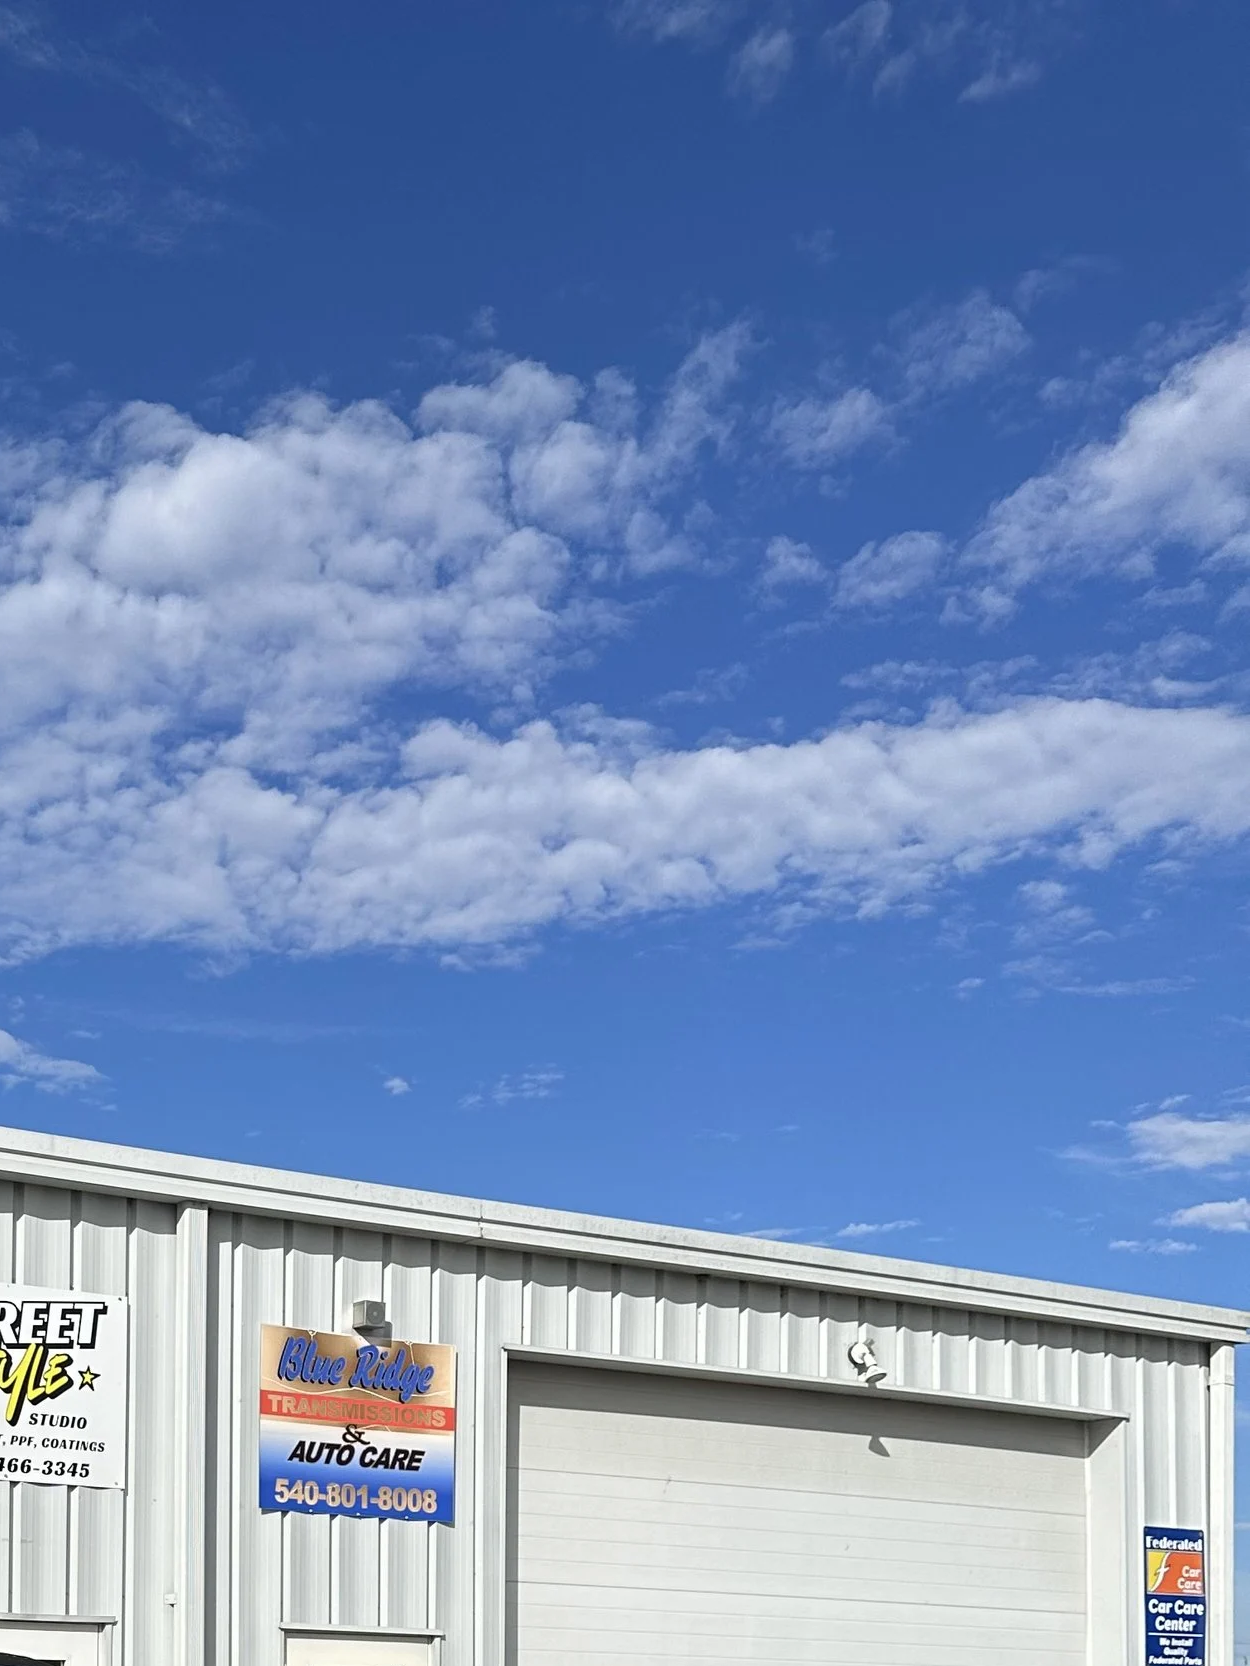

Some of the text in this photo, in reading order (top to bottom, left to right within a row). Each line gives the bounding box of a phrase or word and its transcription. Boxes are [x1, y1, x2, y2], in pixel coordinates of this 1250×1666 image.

[278, 1336, 435, 1404] Blue Ridge
[267, 1393, 447, 1428] TRANSMISSIONS
[28, 1412, 88, 1430] STUDIO
[341, 1423, 371, 1445] &
[10, 1435, 38, 1449] PPF,
[41, 1437, 106, 1453] COATINGS
[287, 1440, 426, 1472] AUTO CARE
[274, 1477, 438, 1513] 540-801-8008
[1145, 1535, 1203, 1551] Federated
[1181, 1565, 1202, 1578] Car
[1177, 1577, 1203, 1590] Care
[1148, 1599, 1205, 1616] Car Care
[1154, 1615, 1198, 1632] Center
